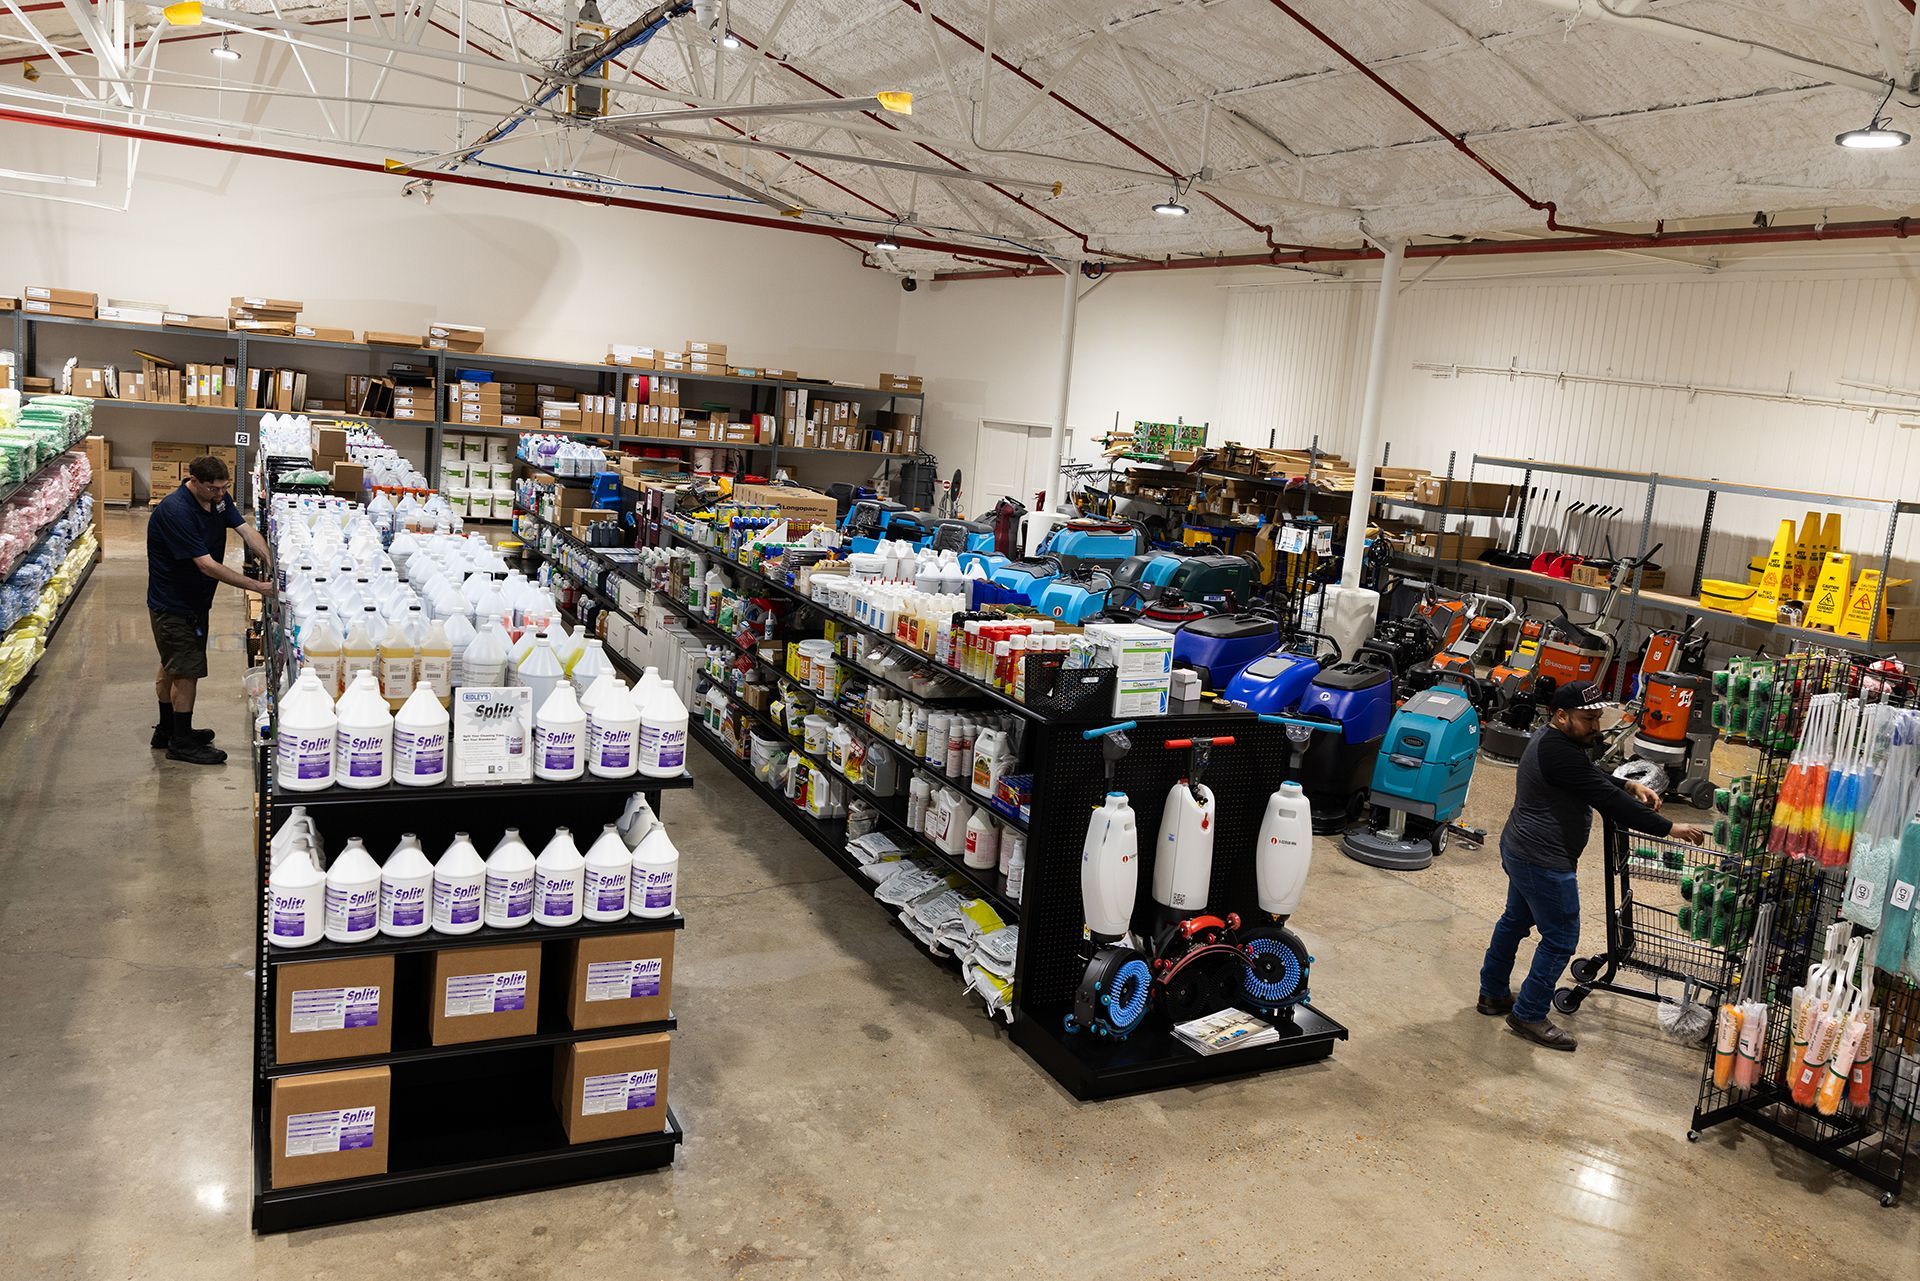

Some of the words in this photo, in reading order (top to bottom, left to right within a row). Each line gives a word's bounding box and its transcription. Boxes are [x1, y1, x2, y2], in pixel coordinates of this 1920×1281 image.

[474, 702, 515, 722] Split!
[352, 735, 383, 751] Split!
[416, 734, 445, 750] Split!
[546, 731, 576, 746] Split!
[603, 730, 632, 744] Split!
[660, 729, 686, 744] Split!
[299, 737, 331, 753] Split!
[546, 879, 574, 893] Split!
[600, 874, 626, 888] Split!
[647, 872, 674, 885] Split!
[349, 890, 378, 905] Split!
[395, 887, 425, 901] Split!
[453, 885, 481, 899] Split!
[1897, 888, 1907, 902] CPI
[274, 896, 306, 910] Split!
[633, 960, 661, 975] Split!
[495, 973, 526, 988] Split!
[346, 988, 379, 1004] Split!
[1816, 1038, 1831, 1062] Wand
[629, 1072, 657, 1087] Split!
[341, 1109, 374, 1126] Split!
